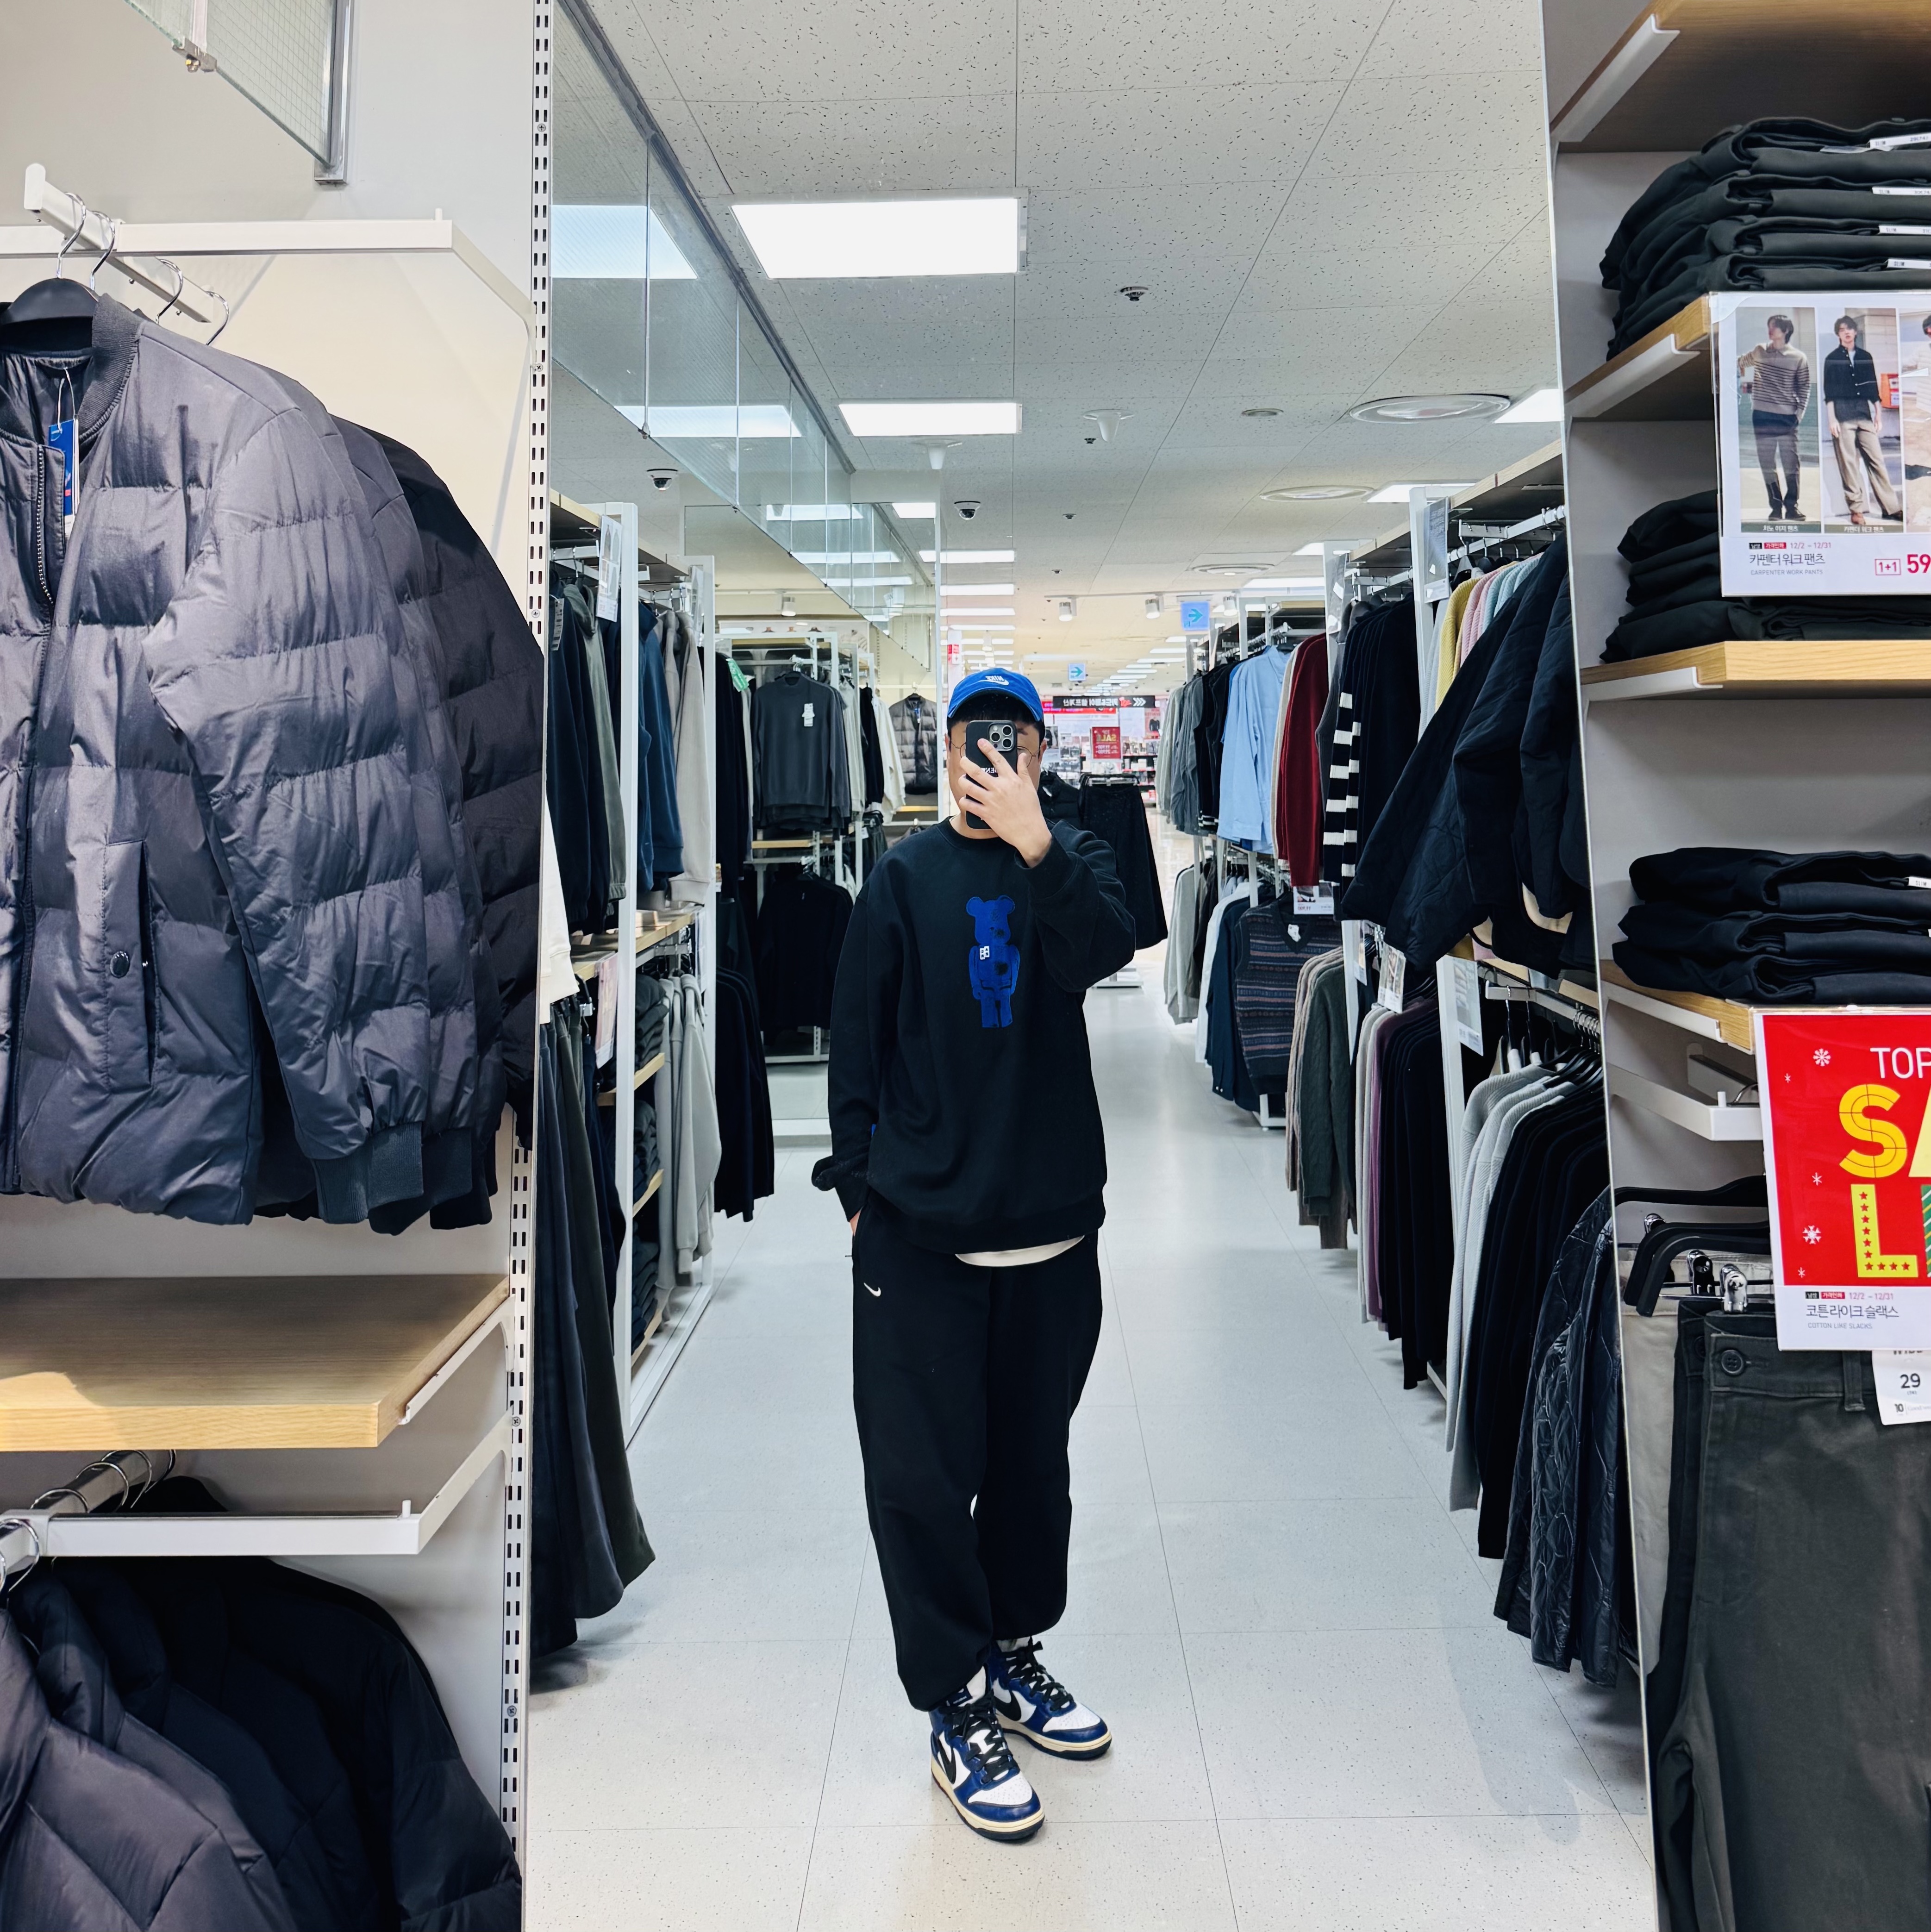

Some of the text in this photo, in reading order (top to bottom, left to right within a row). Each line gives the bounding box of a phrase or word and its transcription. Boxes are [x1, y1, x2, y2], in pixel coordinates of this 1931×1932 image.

[1750, 553, 1825, 566] 카펜터 워크 팬츠
[1879, 554, 1931, 573] 1+1 59
[1869, 1047, 1931, 1079] TOP
[1900, 1373, 1921, 1388] 29
